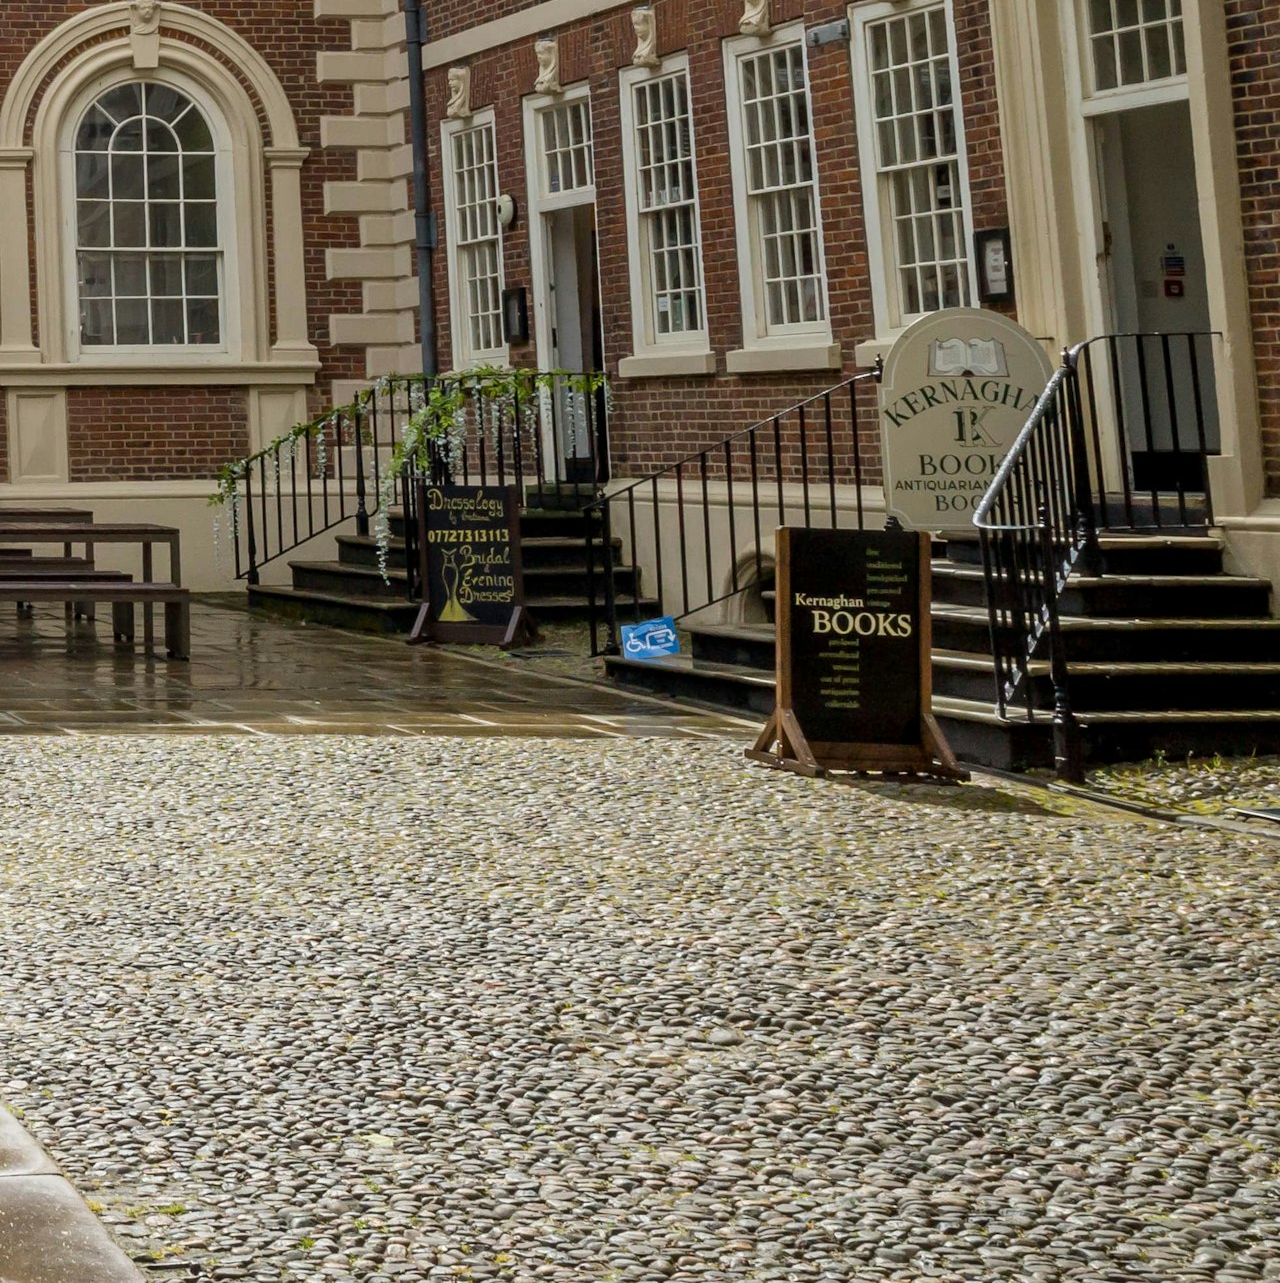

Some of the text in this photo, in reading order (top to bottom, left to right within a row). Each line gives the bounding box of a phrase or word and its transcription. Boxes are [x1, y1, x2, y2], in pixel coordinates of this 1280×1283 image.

[883, 378, 1042, 428] KERNAGHA
[427, 488, 504, 518] Dressology
[427, 529, 510, 543] 07727313113
[459, 545, 510, 571] Bridal
[459, 586, 512, 604] Dresses
[462, 569, 514, 596] Evening
[795, 593, 864, 610] Kernaghan
[811, 610, 912, 637] BOOKS
